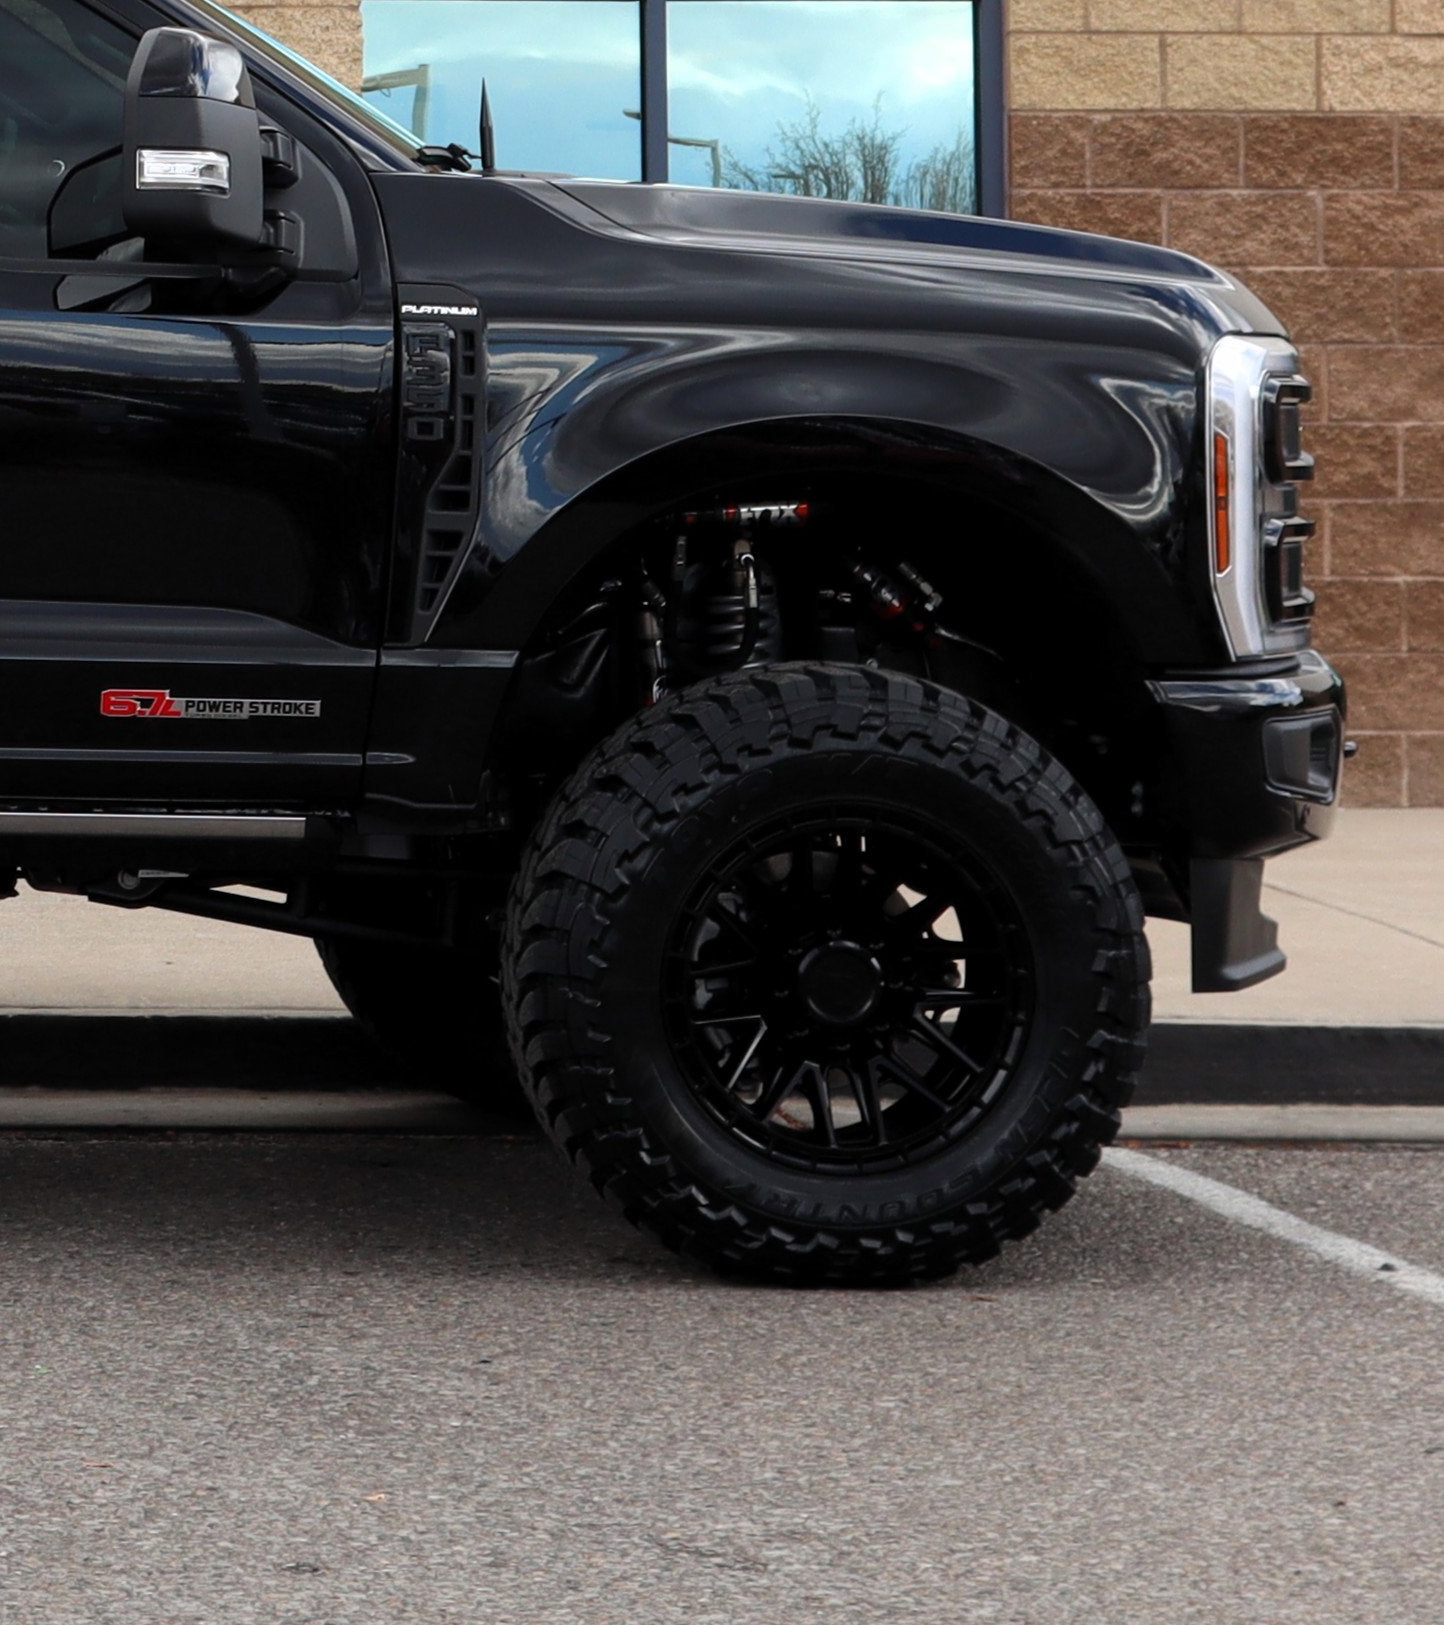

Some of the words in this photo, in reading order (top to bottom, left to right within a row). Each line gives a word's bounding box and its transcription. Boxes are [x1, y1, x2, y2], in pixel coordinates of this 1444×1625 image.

[401, 304, 478, 316] PLATINUM
[100, 688, 183, 717] 6.7L
[184, 699, 244, 714] POWER
[248, 700, 315, 715] STROKE
